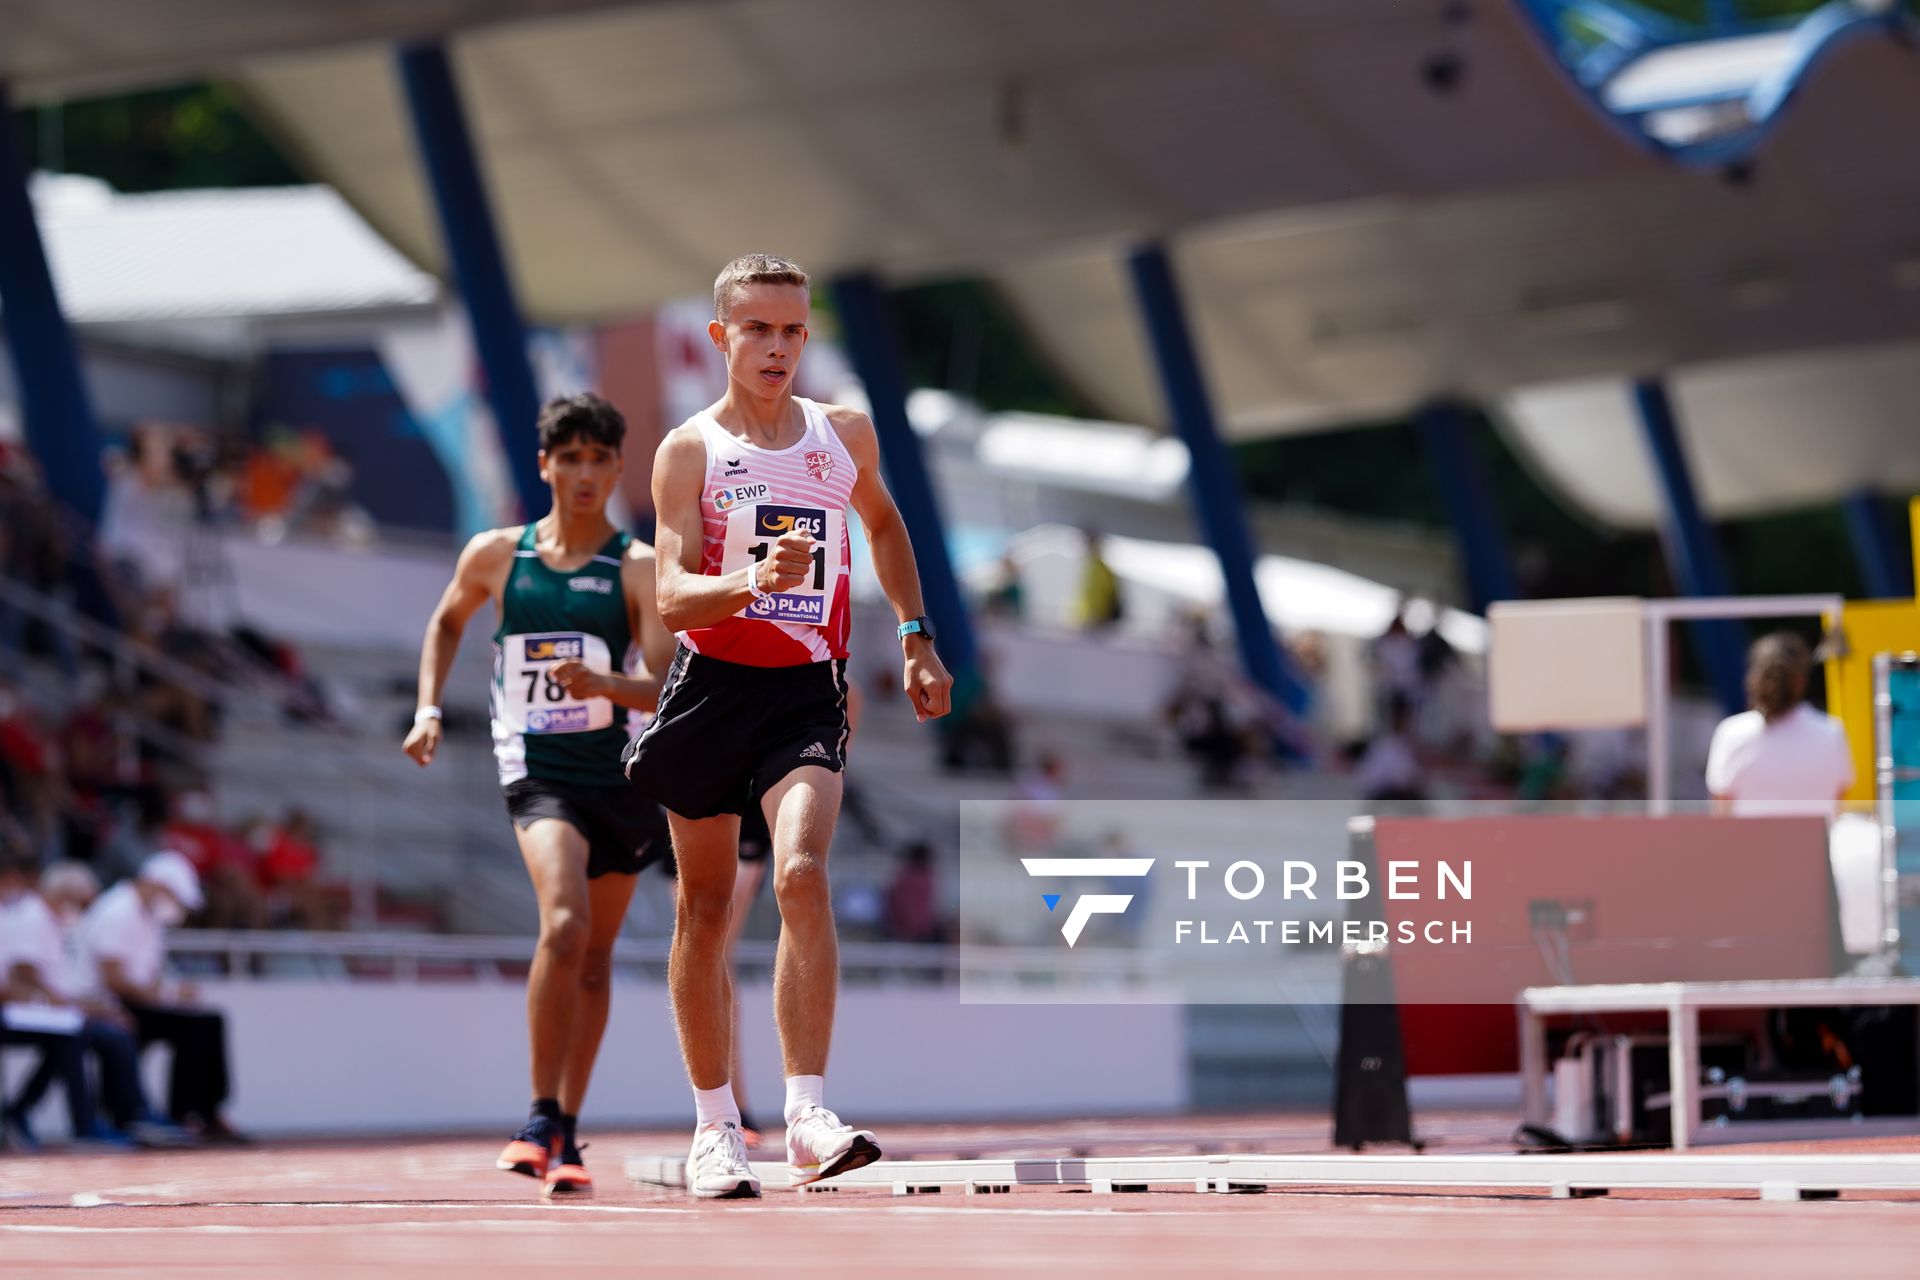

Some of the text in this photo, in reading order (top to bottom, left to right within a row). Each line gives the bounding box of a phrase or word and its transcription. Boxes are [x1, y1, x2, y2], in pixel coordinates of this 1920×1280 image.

[807, 456, 818, 466] SC
[725, 467, 748, 477] erima
[735, 484, 767, 500] EWP
[794, 517, 820, 533] GLS
[748, 543, 825, 590] 11
[779, 598, 820, 613] PLAN
[522, 670, 567, 703] 78
[800, 751, 830, 760] adidas
